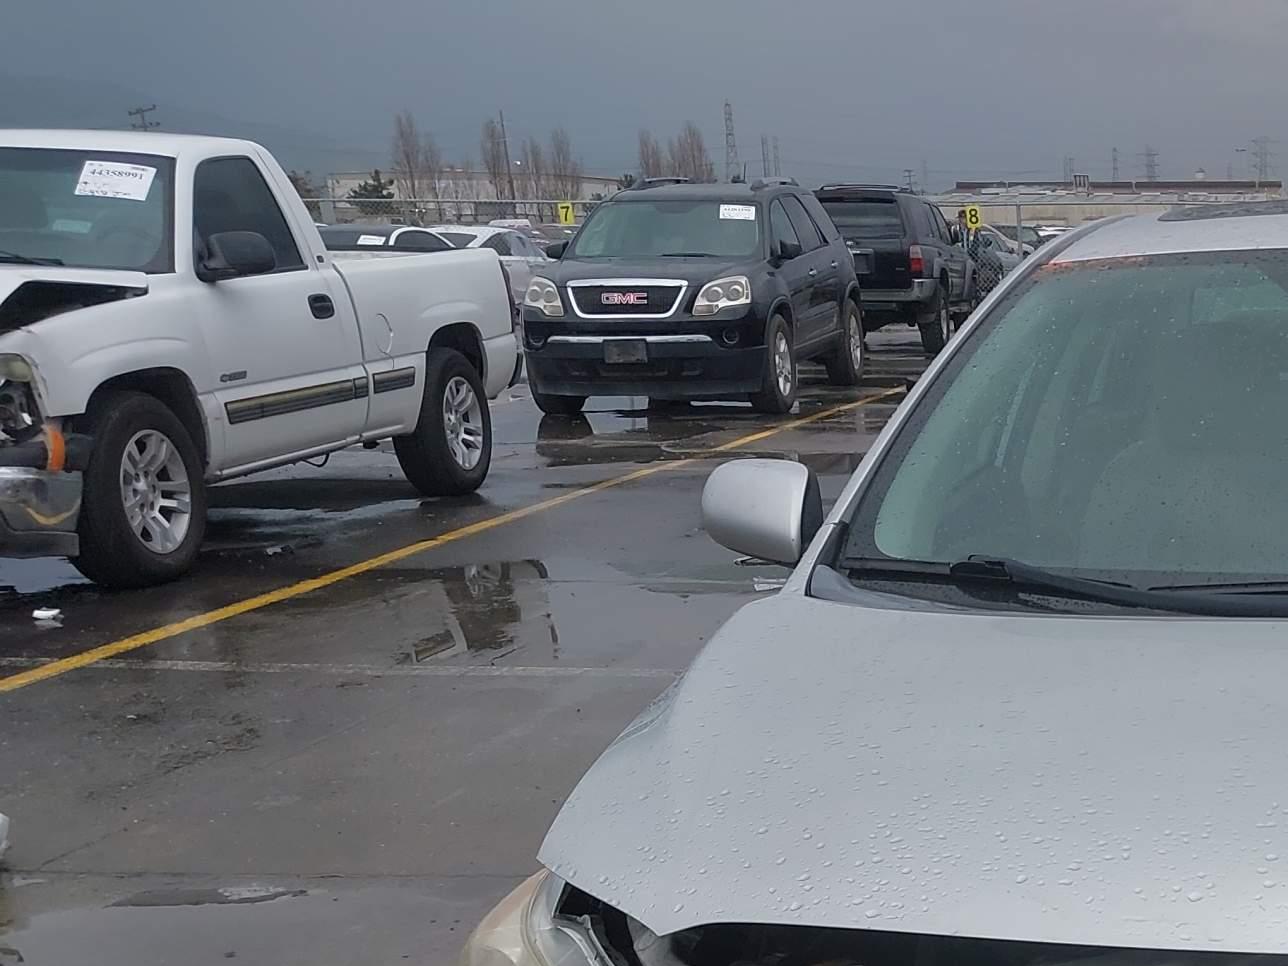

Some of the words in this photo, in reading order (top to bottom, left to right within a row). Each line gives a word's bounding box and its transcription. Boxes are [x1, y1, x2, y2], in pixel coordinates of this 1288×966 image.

[560, 205, 570, 222] 7
[969, 208, 979, 225] 8
[601, 292, 648, 304] GMC
